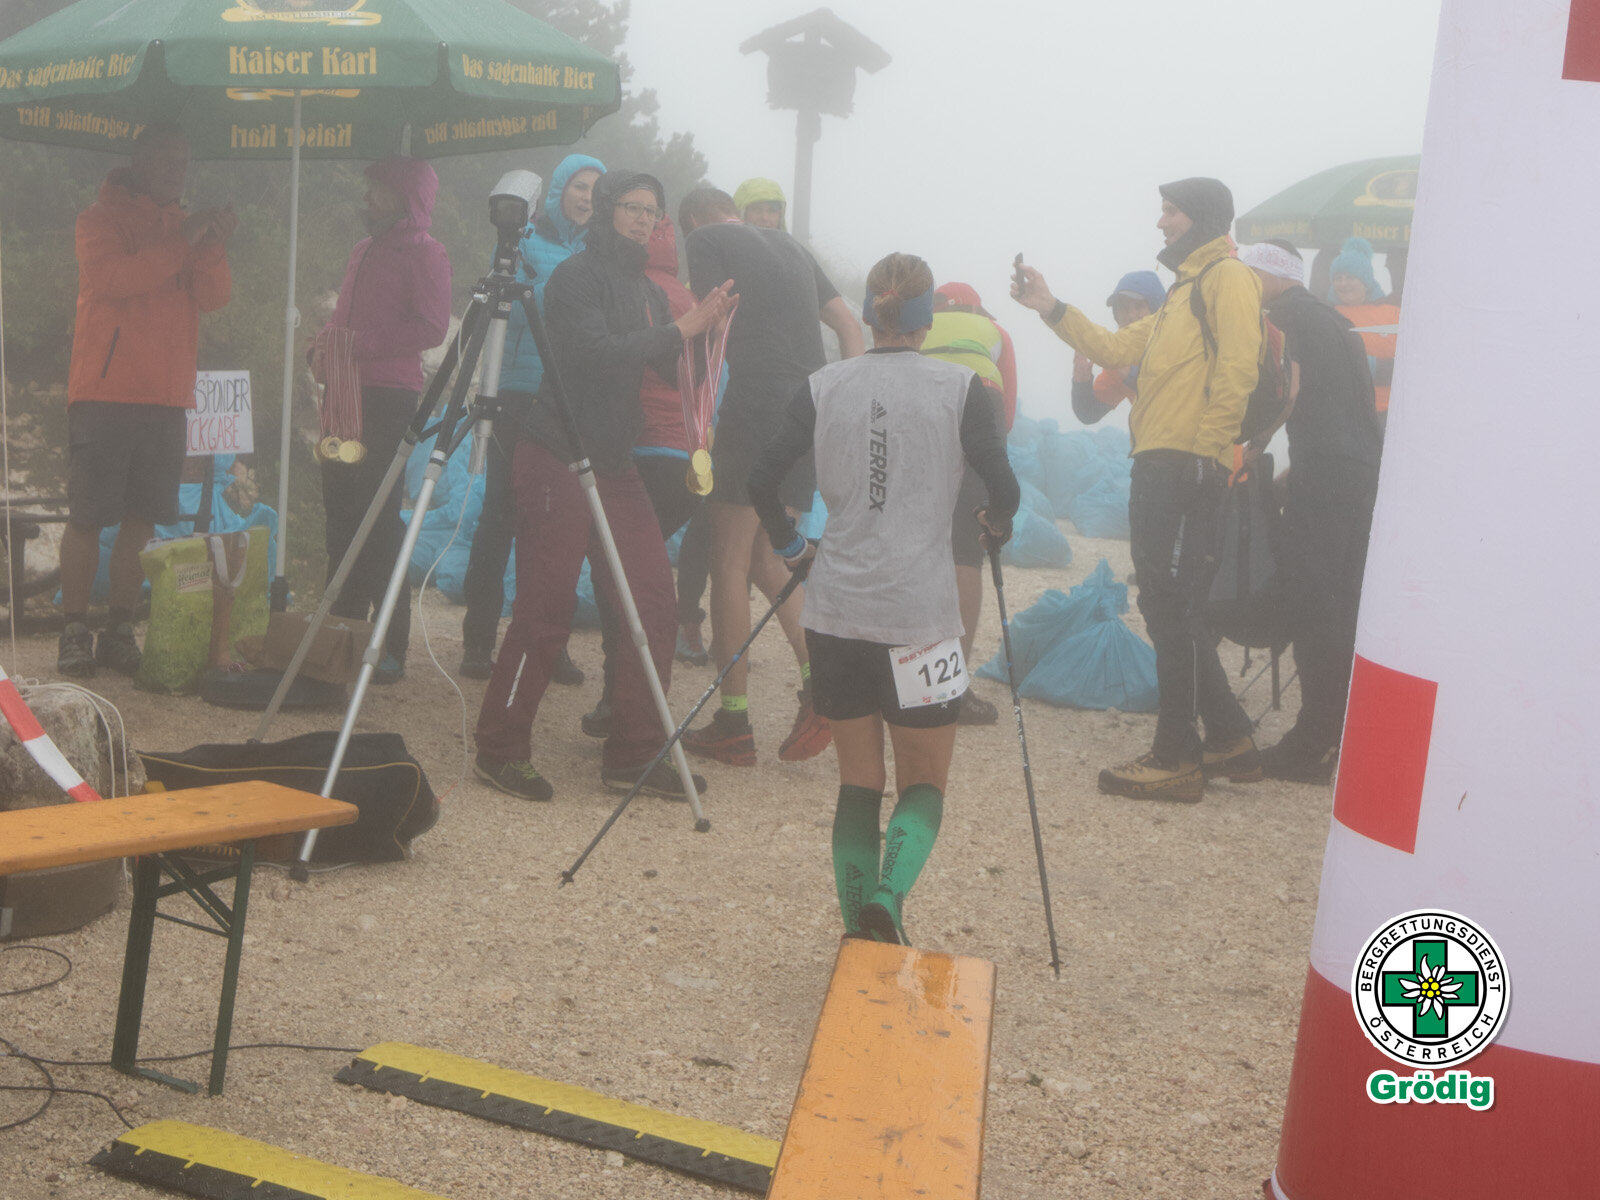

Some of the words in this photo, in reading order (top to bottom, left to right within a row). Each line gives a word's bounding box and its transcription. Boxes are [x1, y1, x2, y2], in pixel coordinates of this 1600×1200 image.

[107, 53, 136, 77] Bier
[229, 46, 313, 75] Kaiser
[322, 47, 377, 75] Karl
[462, 54, 483, 79] Das
[563, 66, 596, 90] Bier
[187, 378, 251, 414] SPONDER
[869, 428, 888, 514] TERREX
[918, 651, 962, 687] 122
